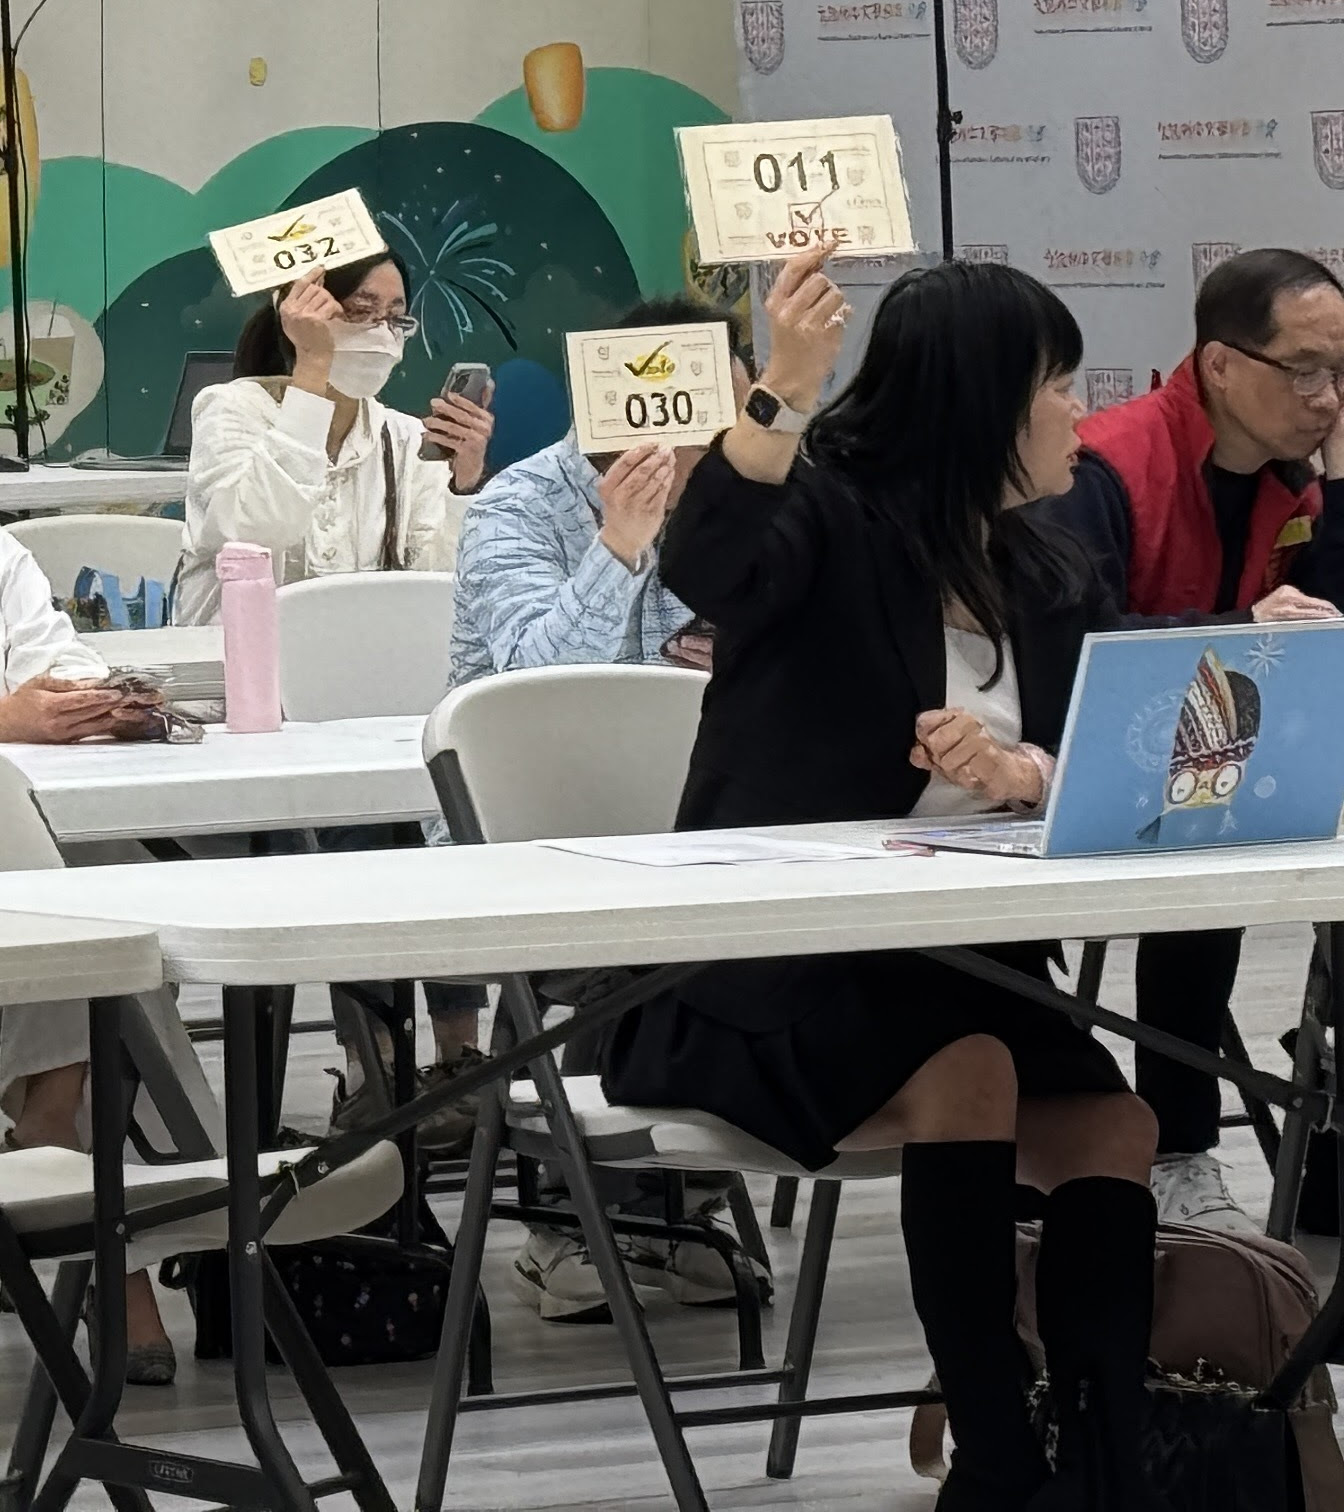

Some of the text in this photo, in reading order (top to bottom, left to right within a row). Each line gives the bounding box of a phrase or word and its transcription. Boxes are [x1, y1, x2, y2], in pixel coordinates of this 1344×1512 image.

[753, 149, 841, 194] 011
[273, 236, 341, 270] 032
[766, 227, 853, 250] VOTE
[625, 390, 694, 429] 030
